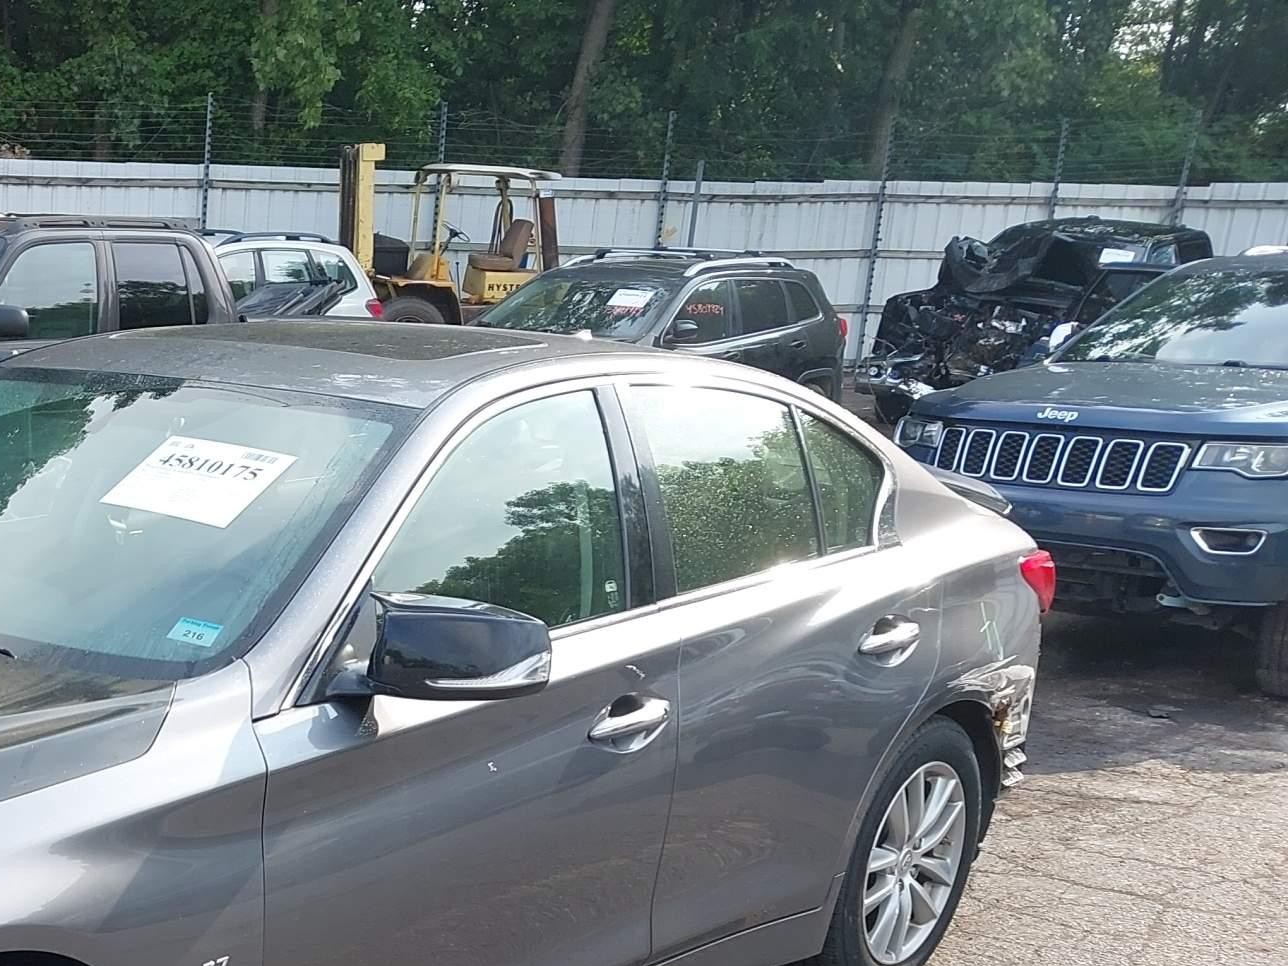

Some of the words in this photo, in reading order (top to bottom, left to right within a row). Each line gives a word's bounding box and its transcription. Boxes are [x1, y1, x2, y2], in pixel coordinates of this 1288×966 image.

[1036, 407, 1079, 423] Jeep
[158, 453, 264, 481] 45810175
[182, 629, 205, 641] 216
